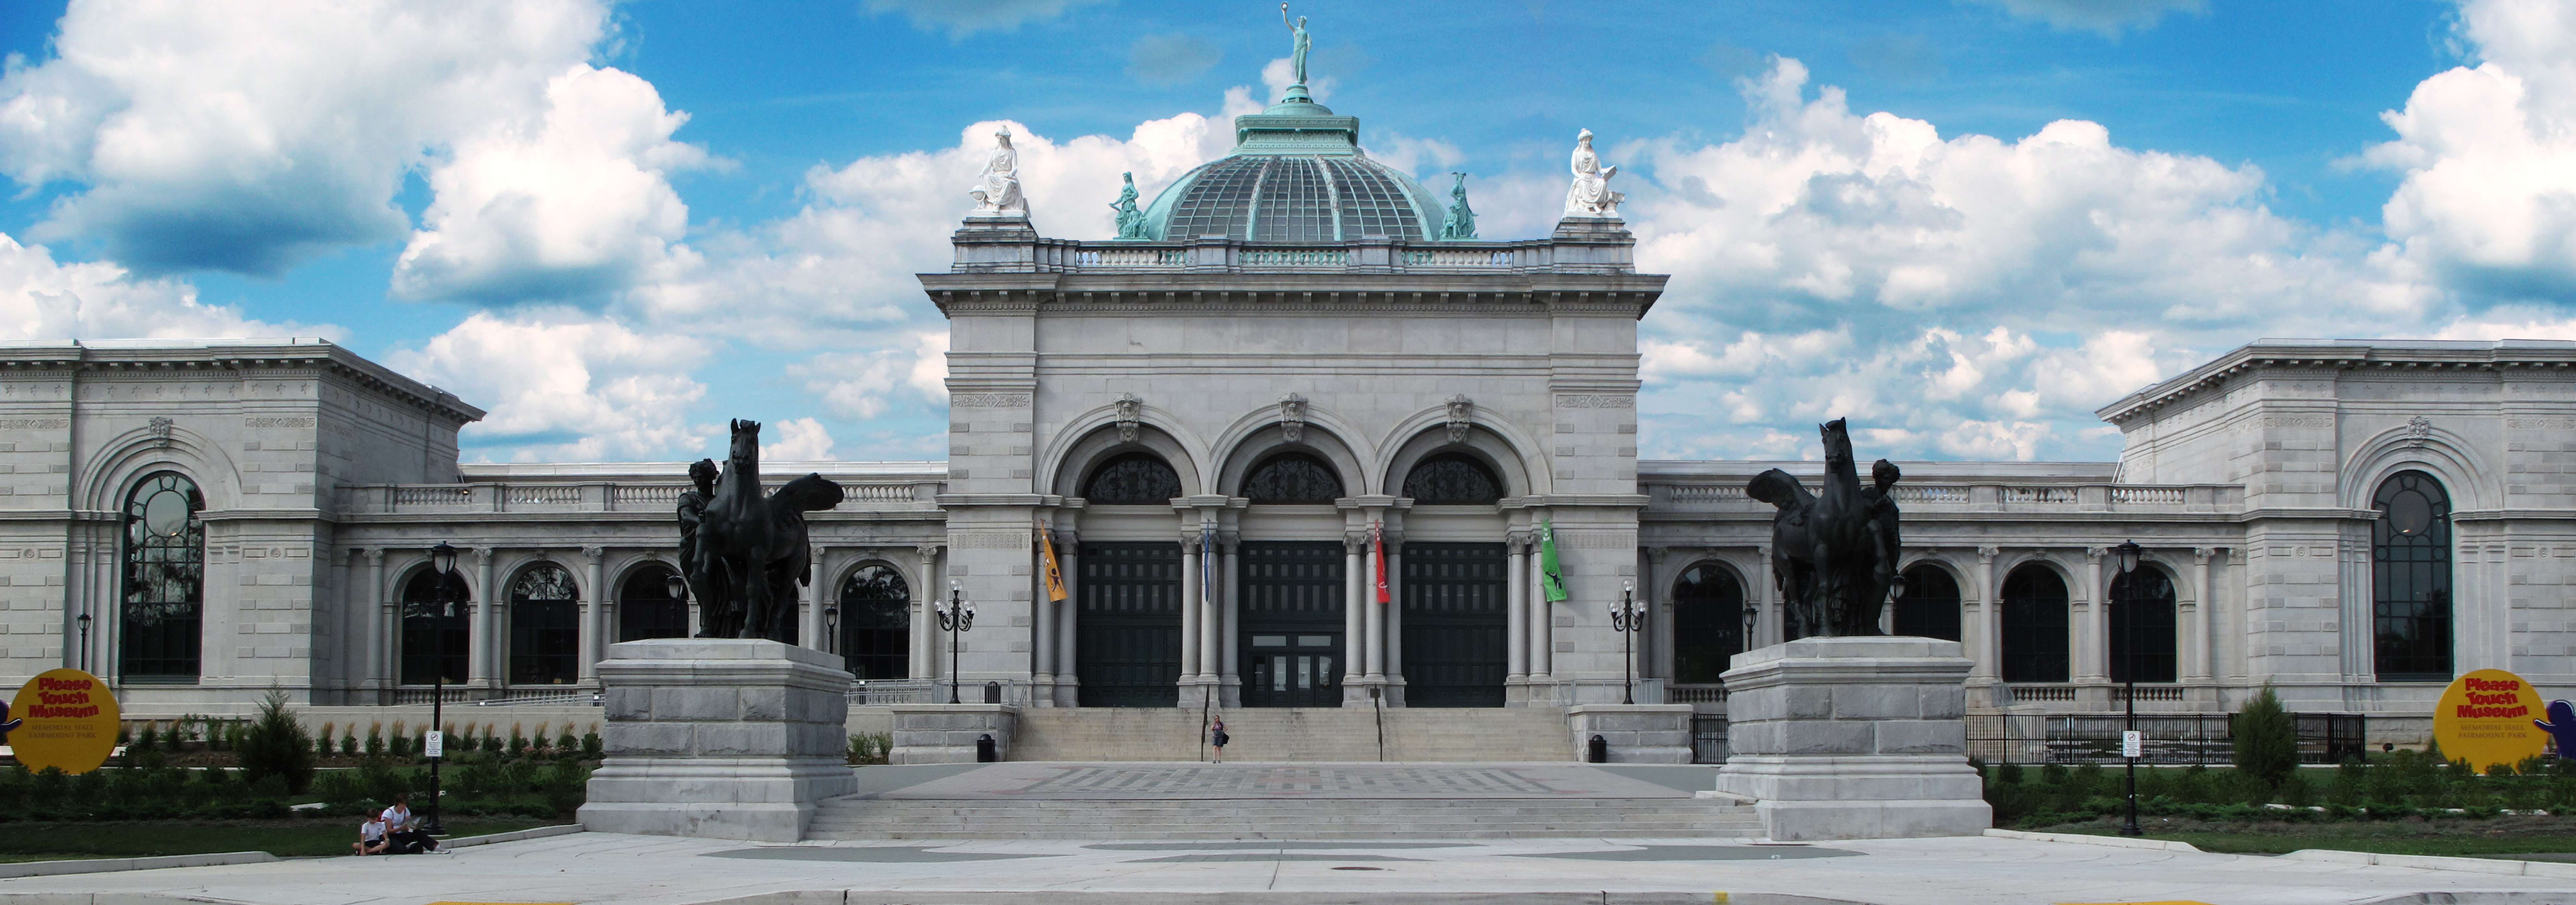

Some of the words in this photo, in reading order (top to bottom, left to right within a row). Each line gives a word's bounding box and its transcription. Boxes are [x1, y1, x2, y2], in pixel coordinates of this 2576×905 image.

[38, 678, 92, 691] Please
[2465, 678, 2519, 691] Please
[38, 692, 90, 704] Touch
[2466, 692, 2518, 705] Touch
[29, 705, 99, 718] Museum
[2457, 705, 2528, 718] Museum
